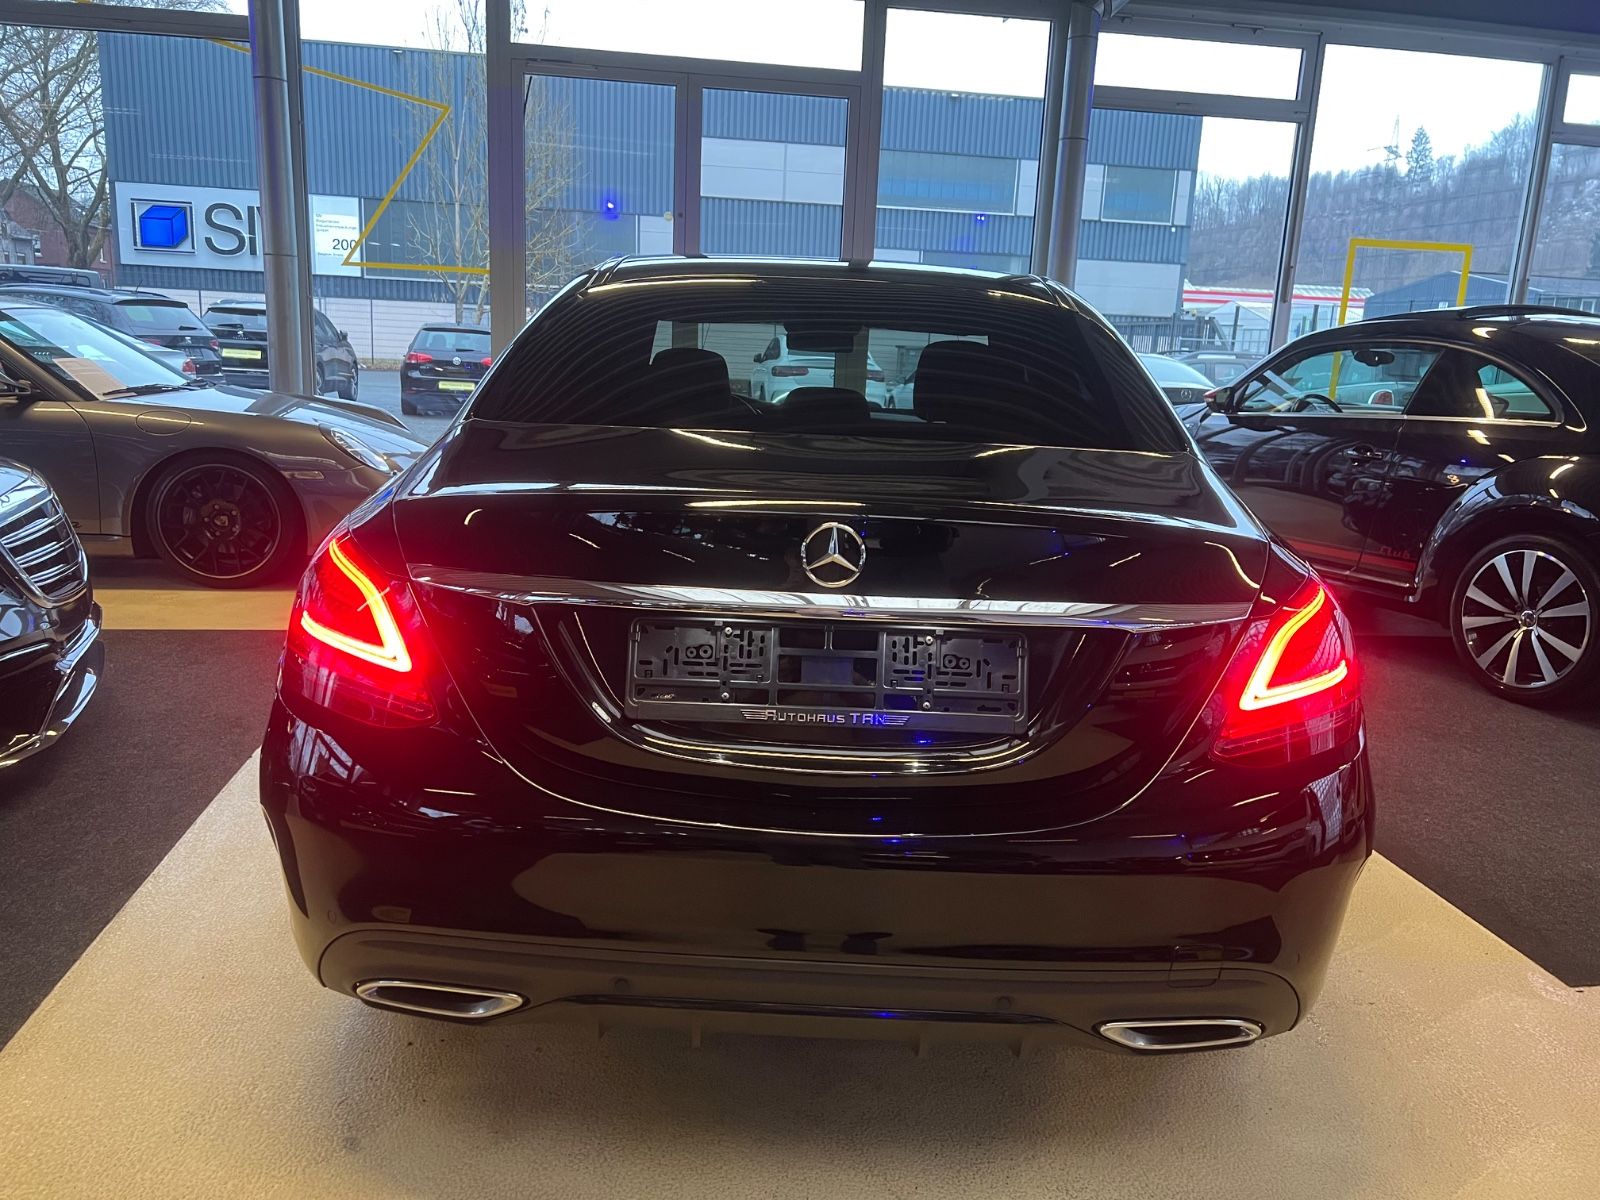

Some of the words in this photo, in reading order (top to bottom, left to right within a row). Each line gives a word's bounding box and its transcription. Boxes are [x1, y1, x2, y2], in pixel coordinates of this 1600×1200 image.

[204, 203, 261, 256] SI
[765, 709, 845, 723] AUTOHAUS
[849, 712, 886, 725] TAN
